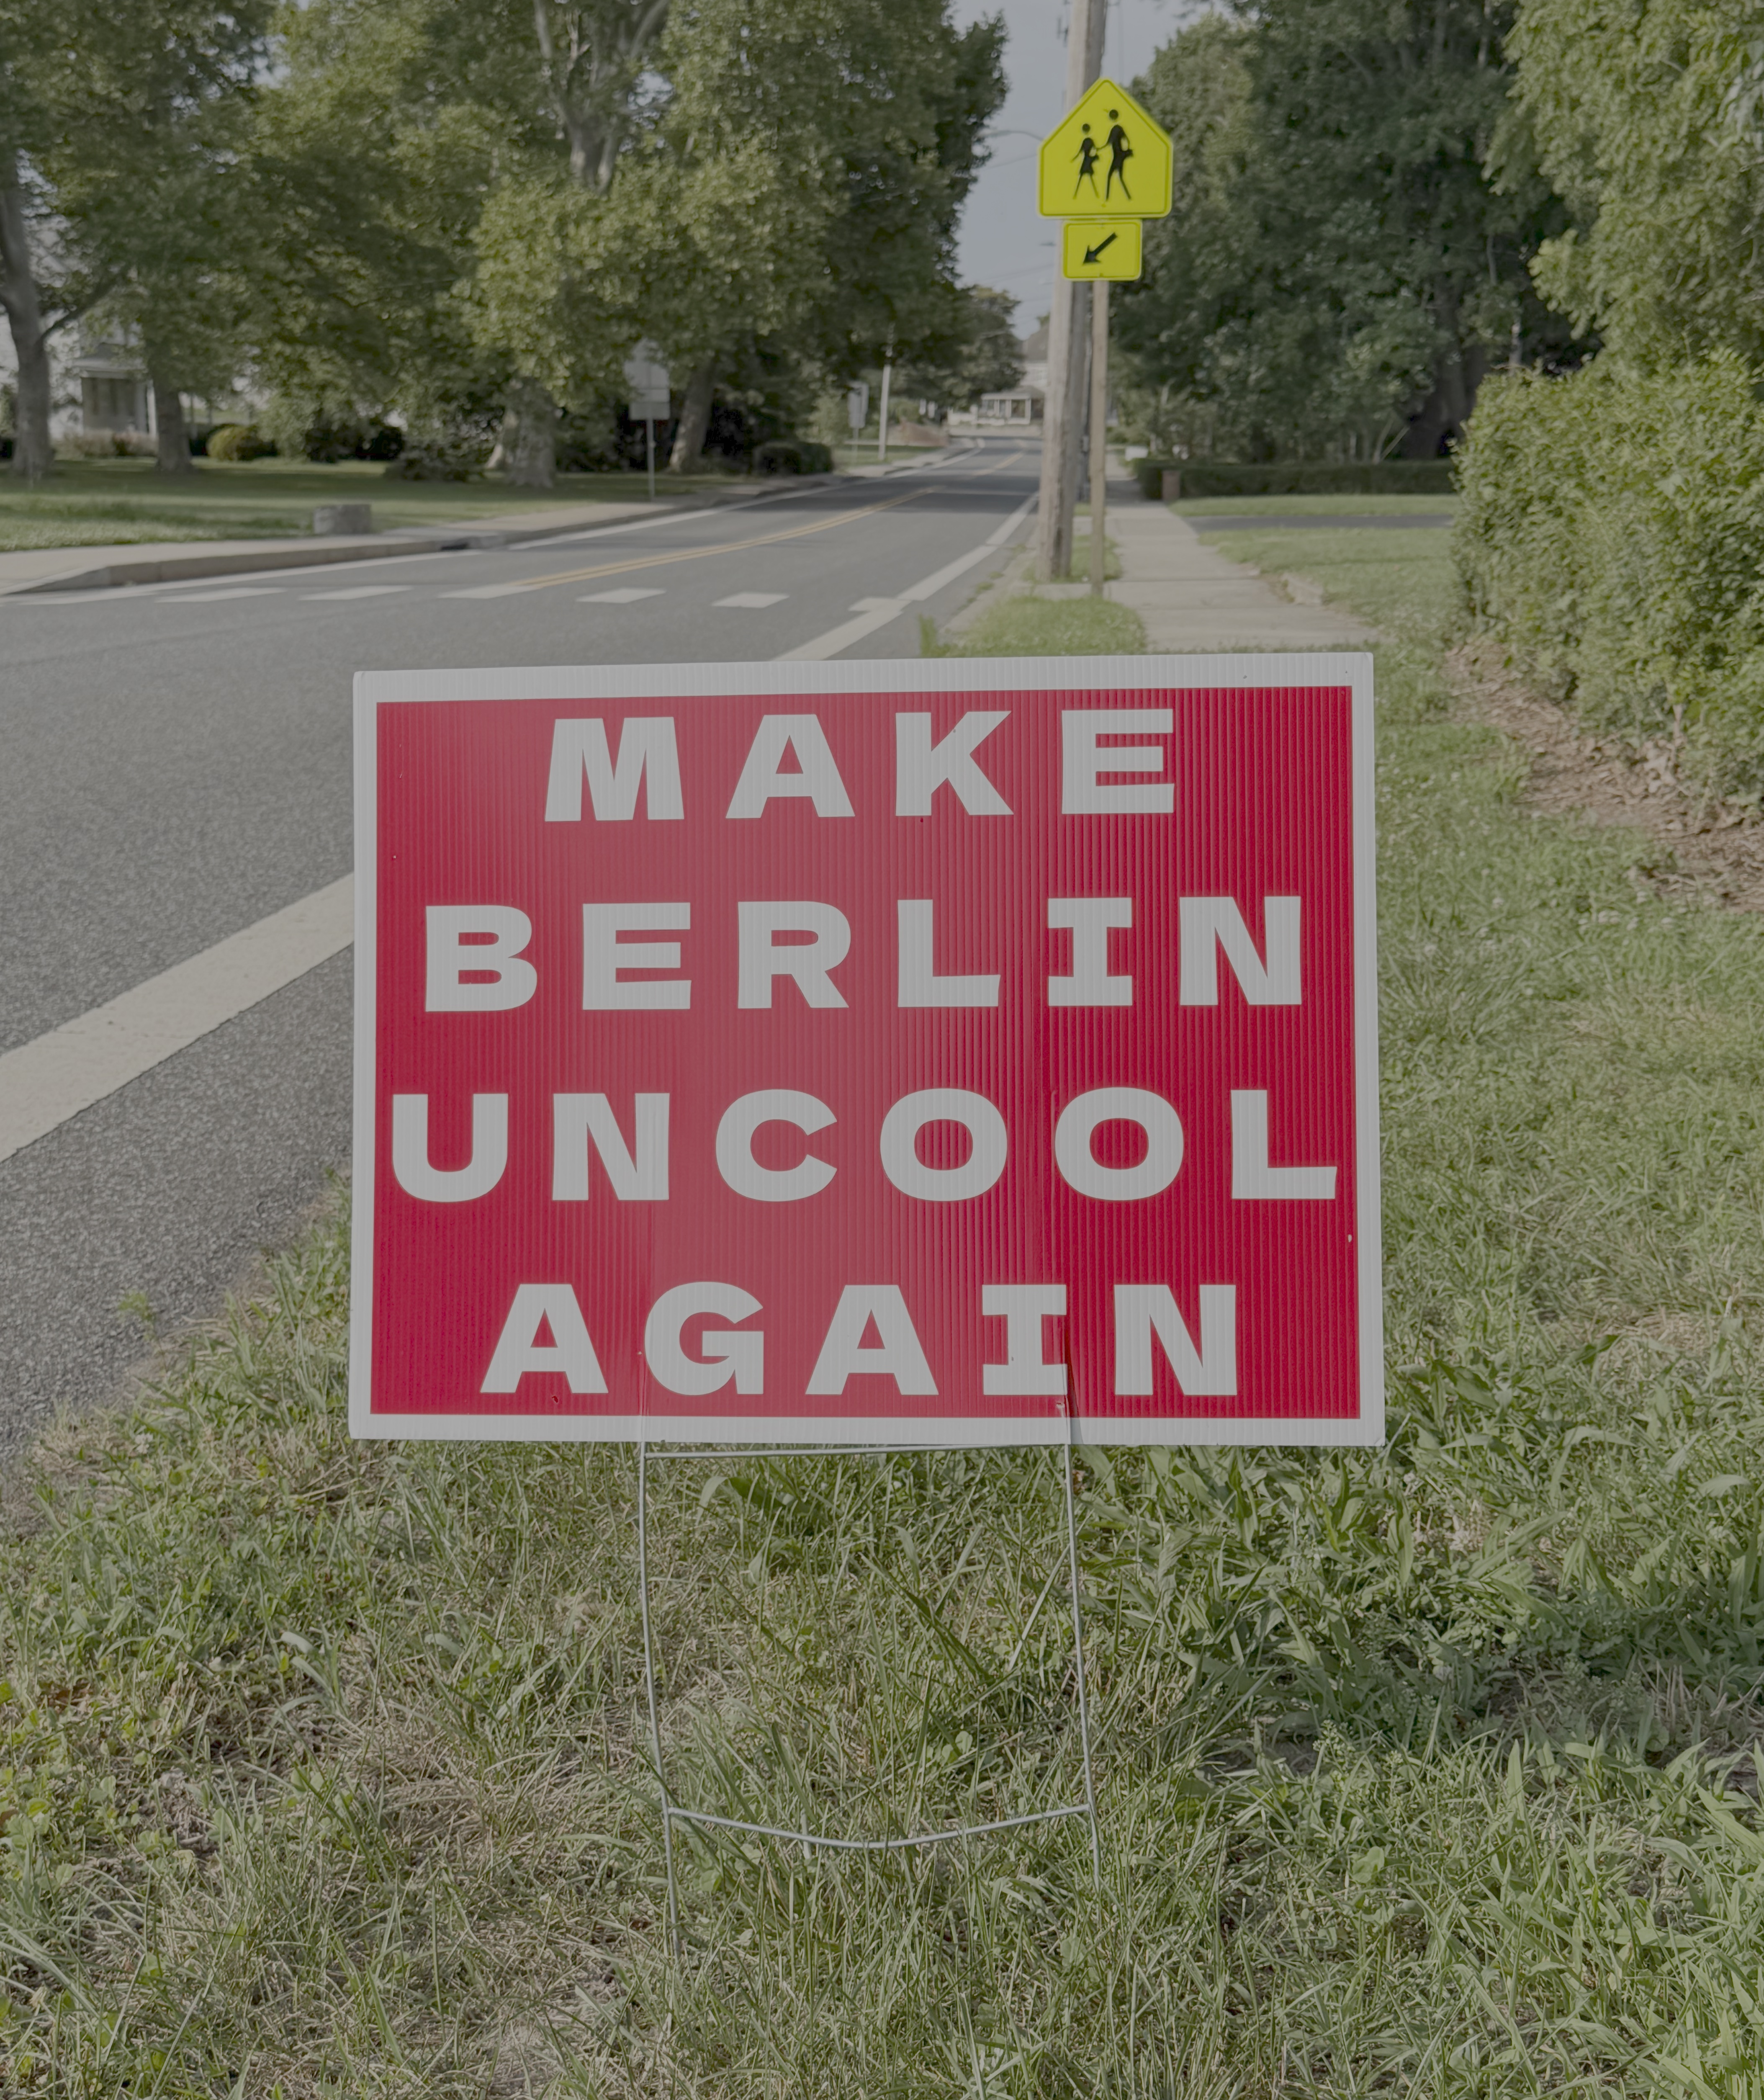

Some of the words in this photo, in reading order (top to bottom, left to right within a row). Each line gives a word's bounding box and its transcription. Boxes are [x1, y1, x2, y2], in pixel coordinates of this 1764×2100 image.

[545, 709, 1174, 821] MAKE
[425, 896, 1301, 1012] BERLIN
[393, 1087, 1337, 1202] UNCOOL
[480, 1282, 1237, 1395] AGAIN
